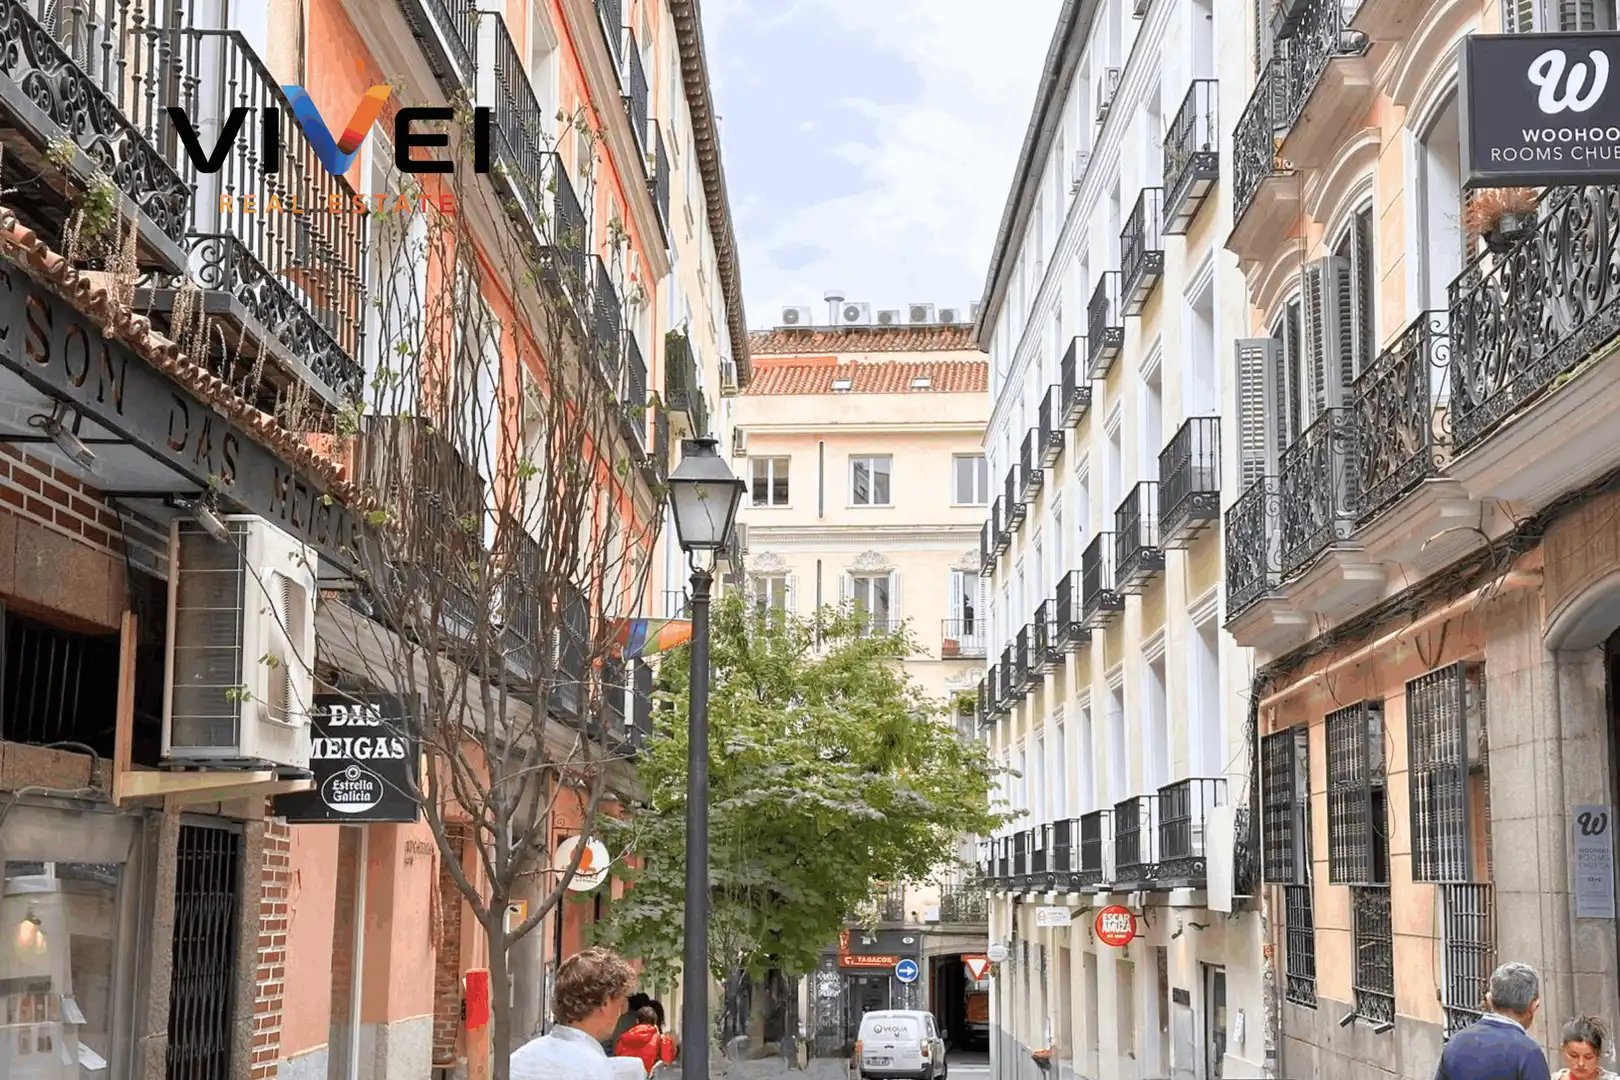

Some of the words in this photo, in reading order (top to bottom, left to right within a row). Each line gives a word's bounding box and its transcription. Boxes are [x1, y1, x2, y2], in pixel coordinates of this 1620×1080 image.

[1522, 127, 1620, 143] WOOHOO
[1491, 146, 1563, 161] ROOMS
[166, 393, 240, 486] DAS
[328, 704, 381, 727] DAS
[332, 780, 373, 791] Estrella
[332, 791, 371, 802] Galicia
[1102, 913, 1130, 921] ESCAR
